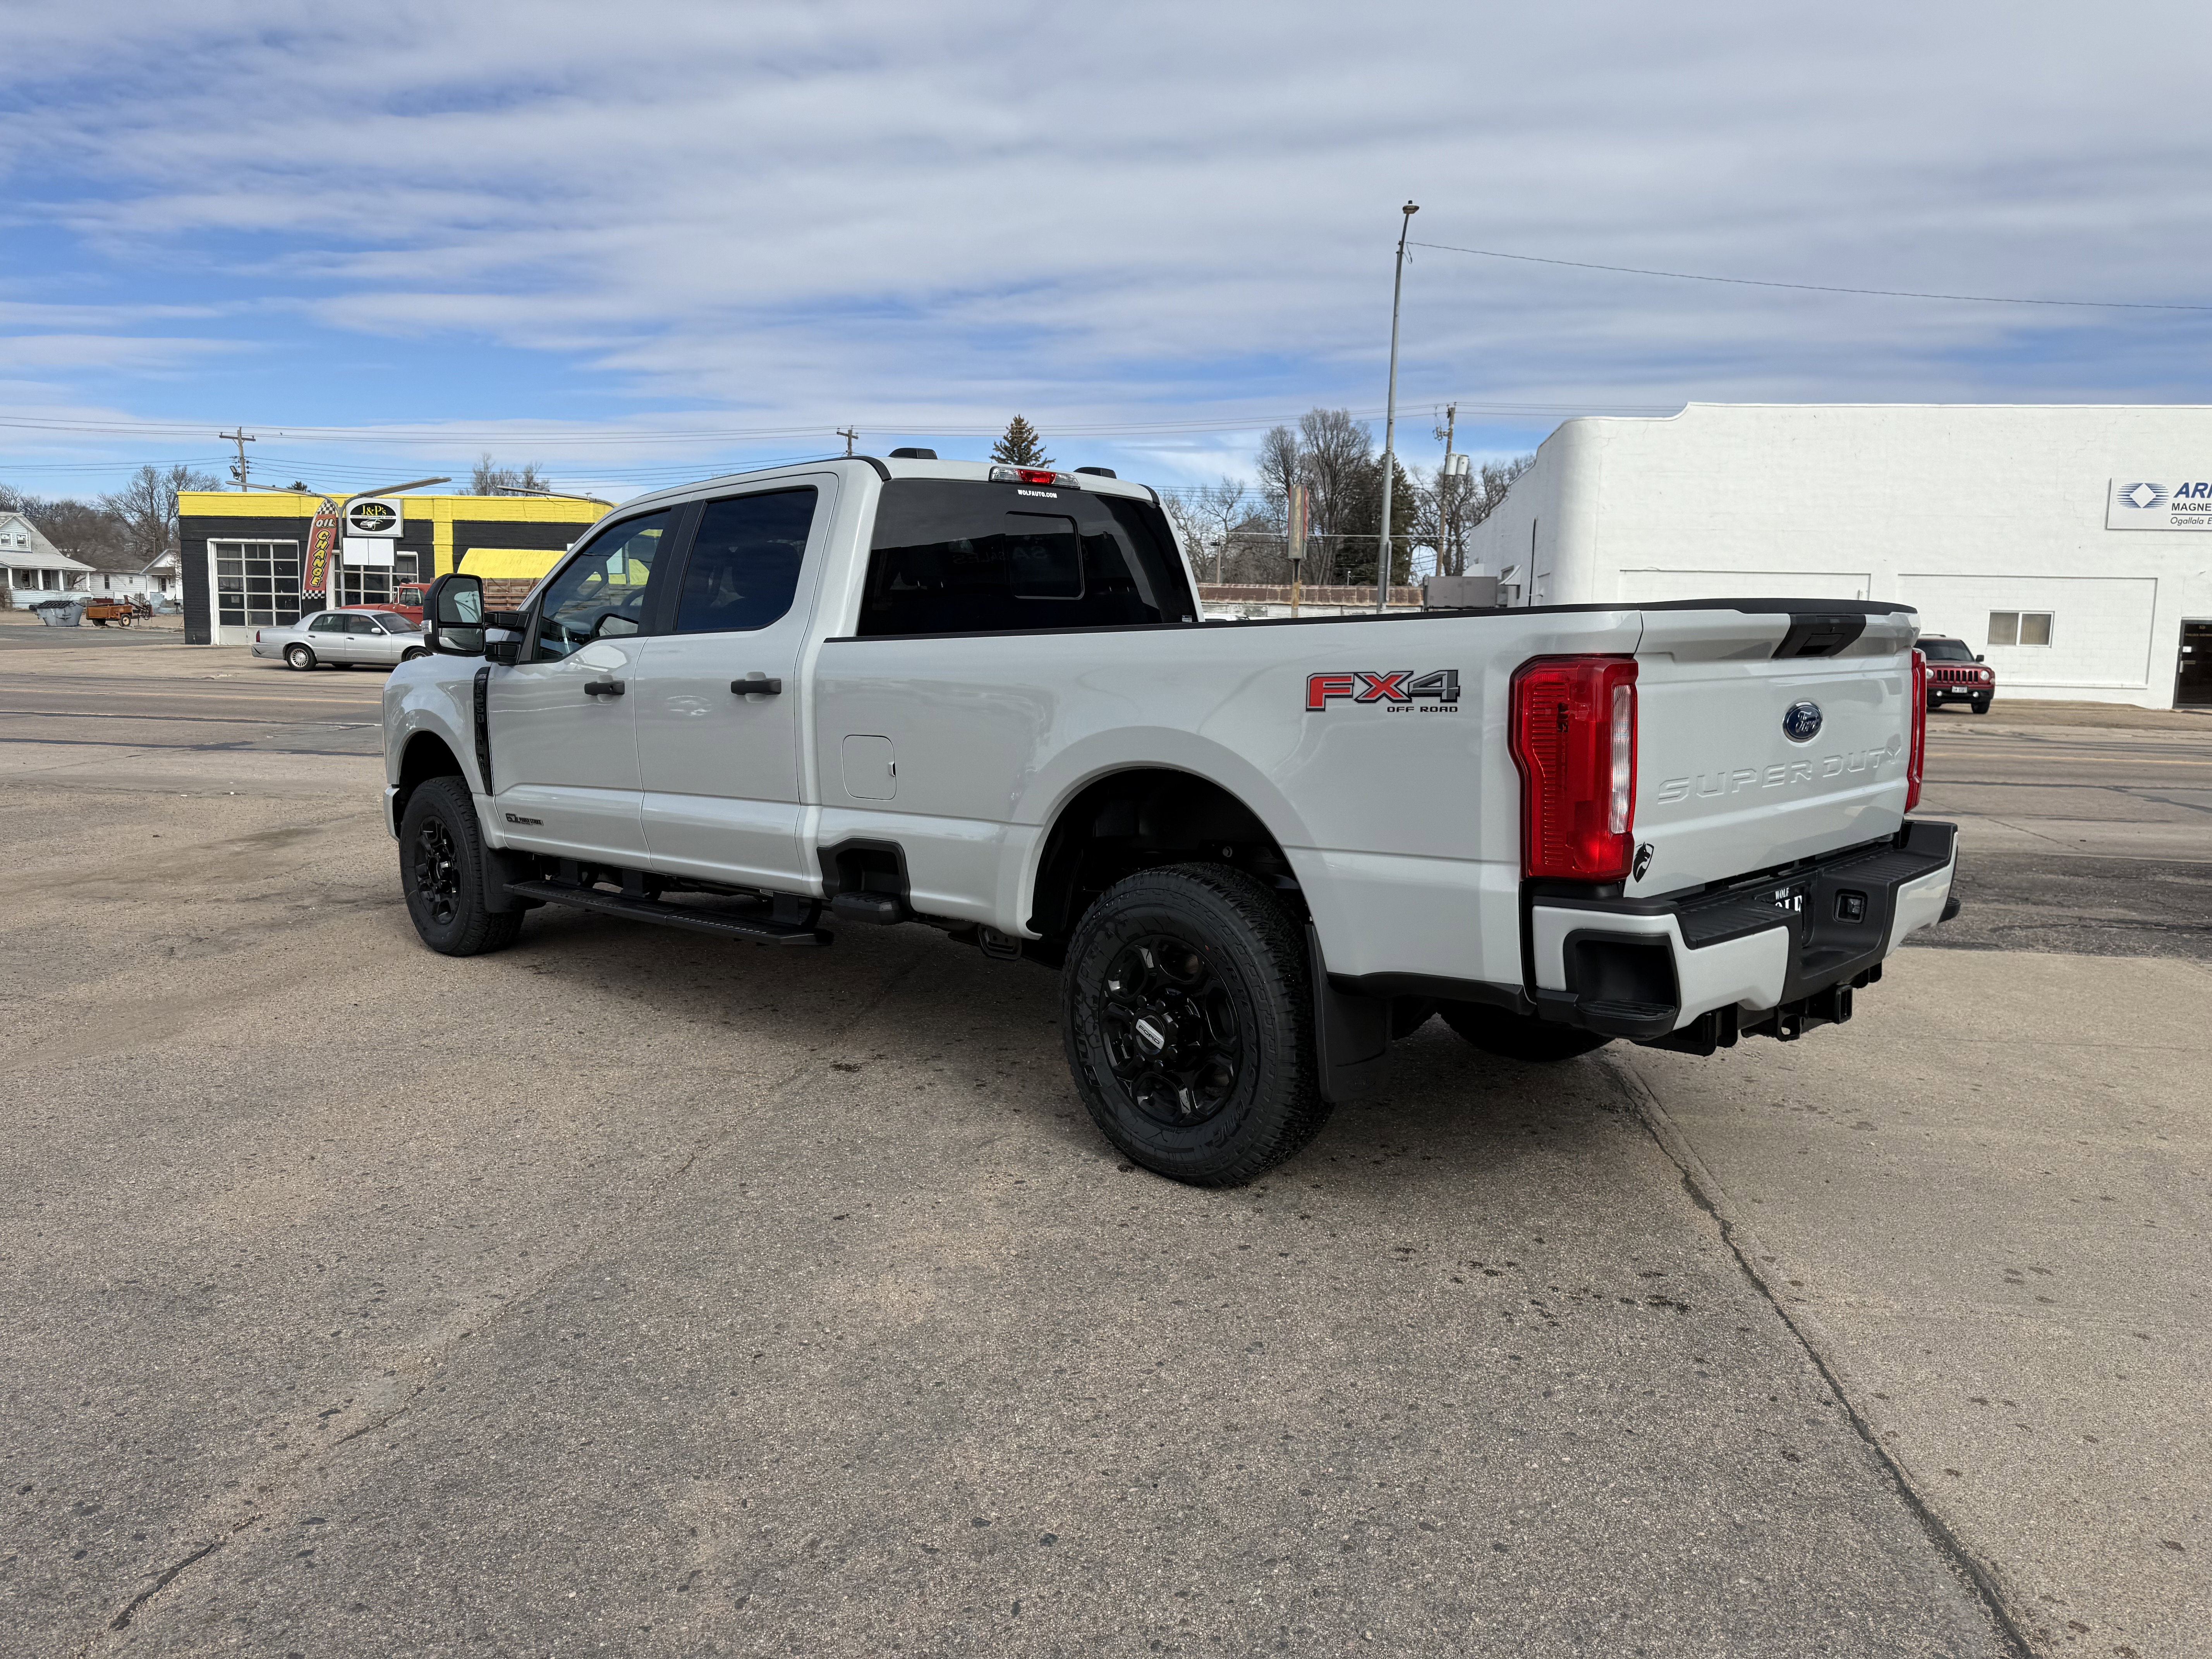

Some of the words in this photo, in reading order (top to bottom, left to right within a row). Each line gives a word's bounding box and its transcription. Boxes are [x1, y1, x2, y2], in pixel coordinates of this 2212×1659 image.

[1017, 489, 1058, 498] WOLFAUTO.COM
[361, 505, 386, 515] J&P's
[2171, 503, 2212, 511] MAGNE
[315, 518, 335, 528] OIL
[2170, 517, 2204, 526] Ogallala
[310, 529, 331, 587] CHANGE
[1305, 669, 1461, 712] FX4
[1657, 760, 1814, 804] SUPER
[1822, 745, 1901, 778] DUTY
[1775, 887, 1790, 900] WOLF
[1139, 1025, 1160, 1044] FORD
